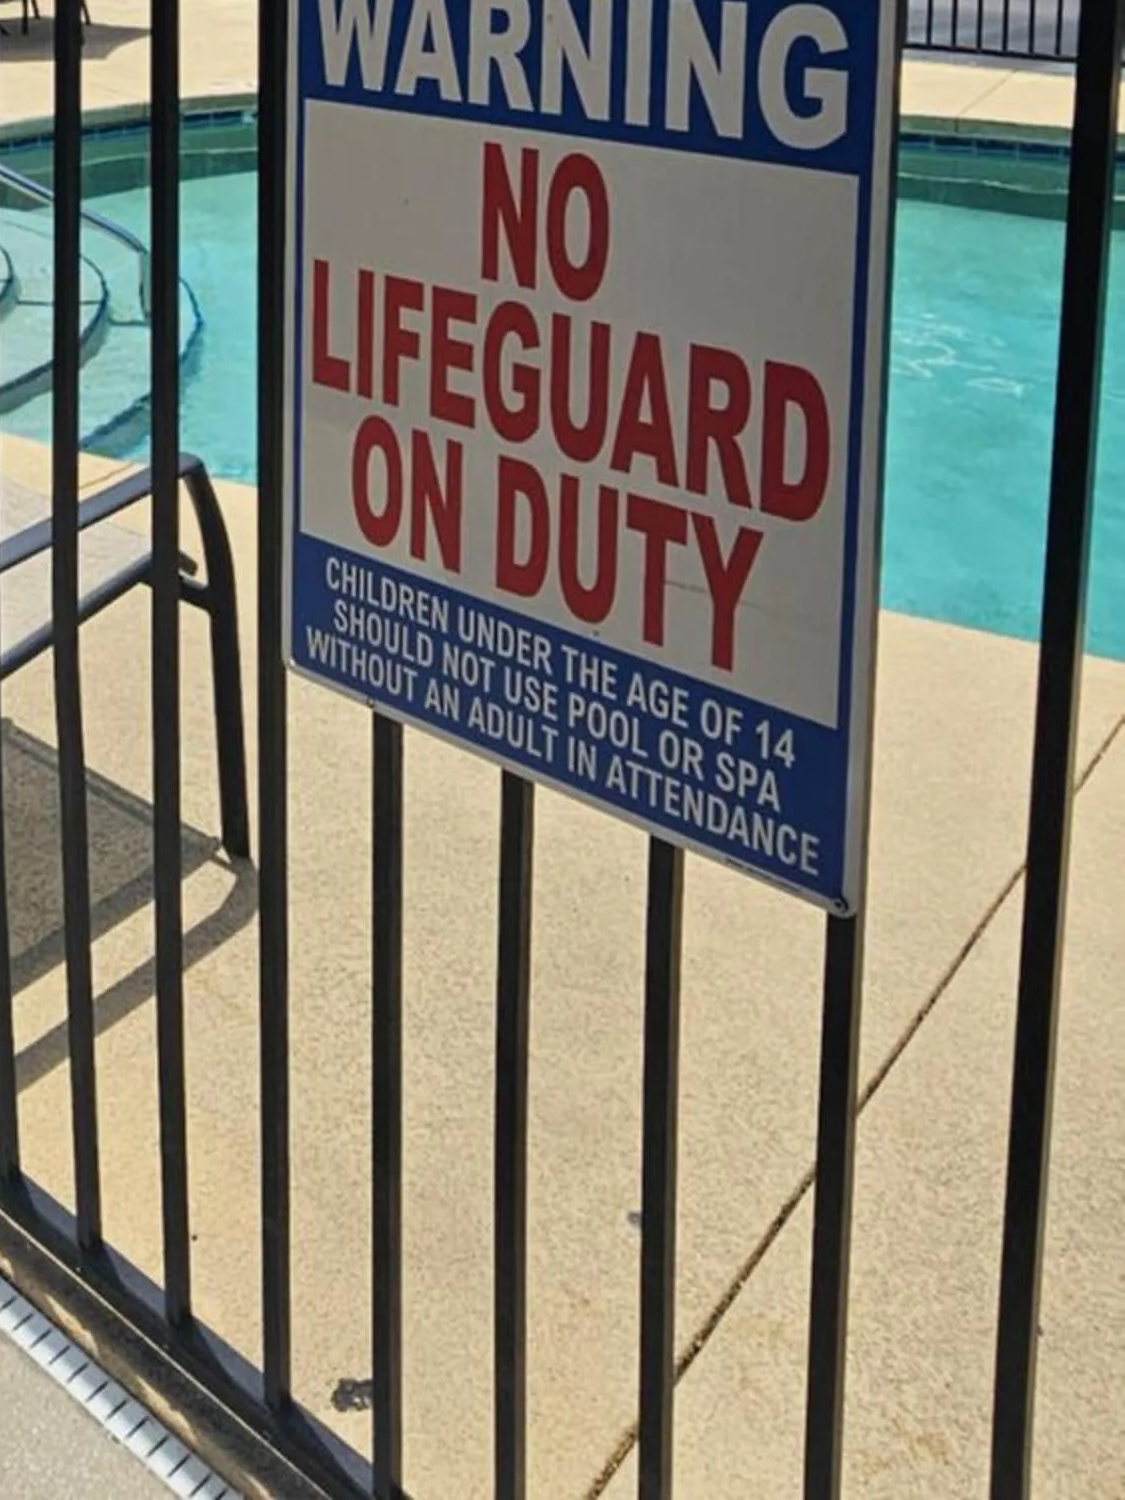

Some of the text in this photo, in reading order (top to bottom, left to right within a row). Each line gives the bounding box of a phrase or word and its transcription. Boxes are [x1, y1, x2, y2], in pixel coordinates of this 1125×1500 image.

[482, 142, 607, 300] NO
[313, 261, 829, 520] LIFEGUARD
[352, 415, 762, 670] ON DUTY
[306, 626, 818, 875] WITHOUT AN ADULT IN ATTENDANCE
[327, 558, 794, 767] CHILDREN UNDER THE AGE OF 14
[335, 601, 779, 811] SHOULD NOT USE POOL OR SPA
